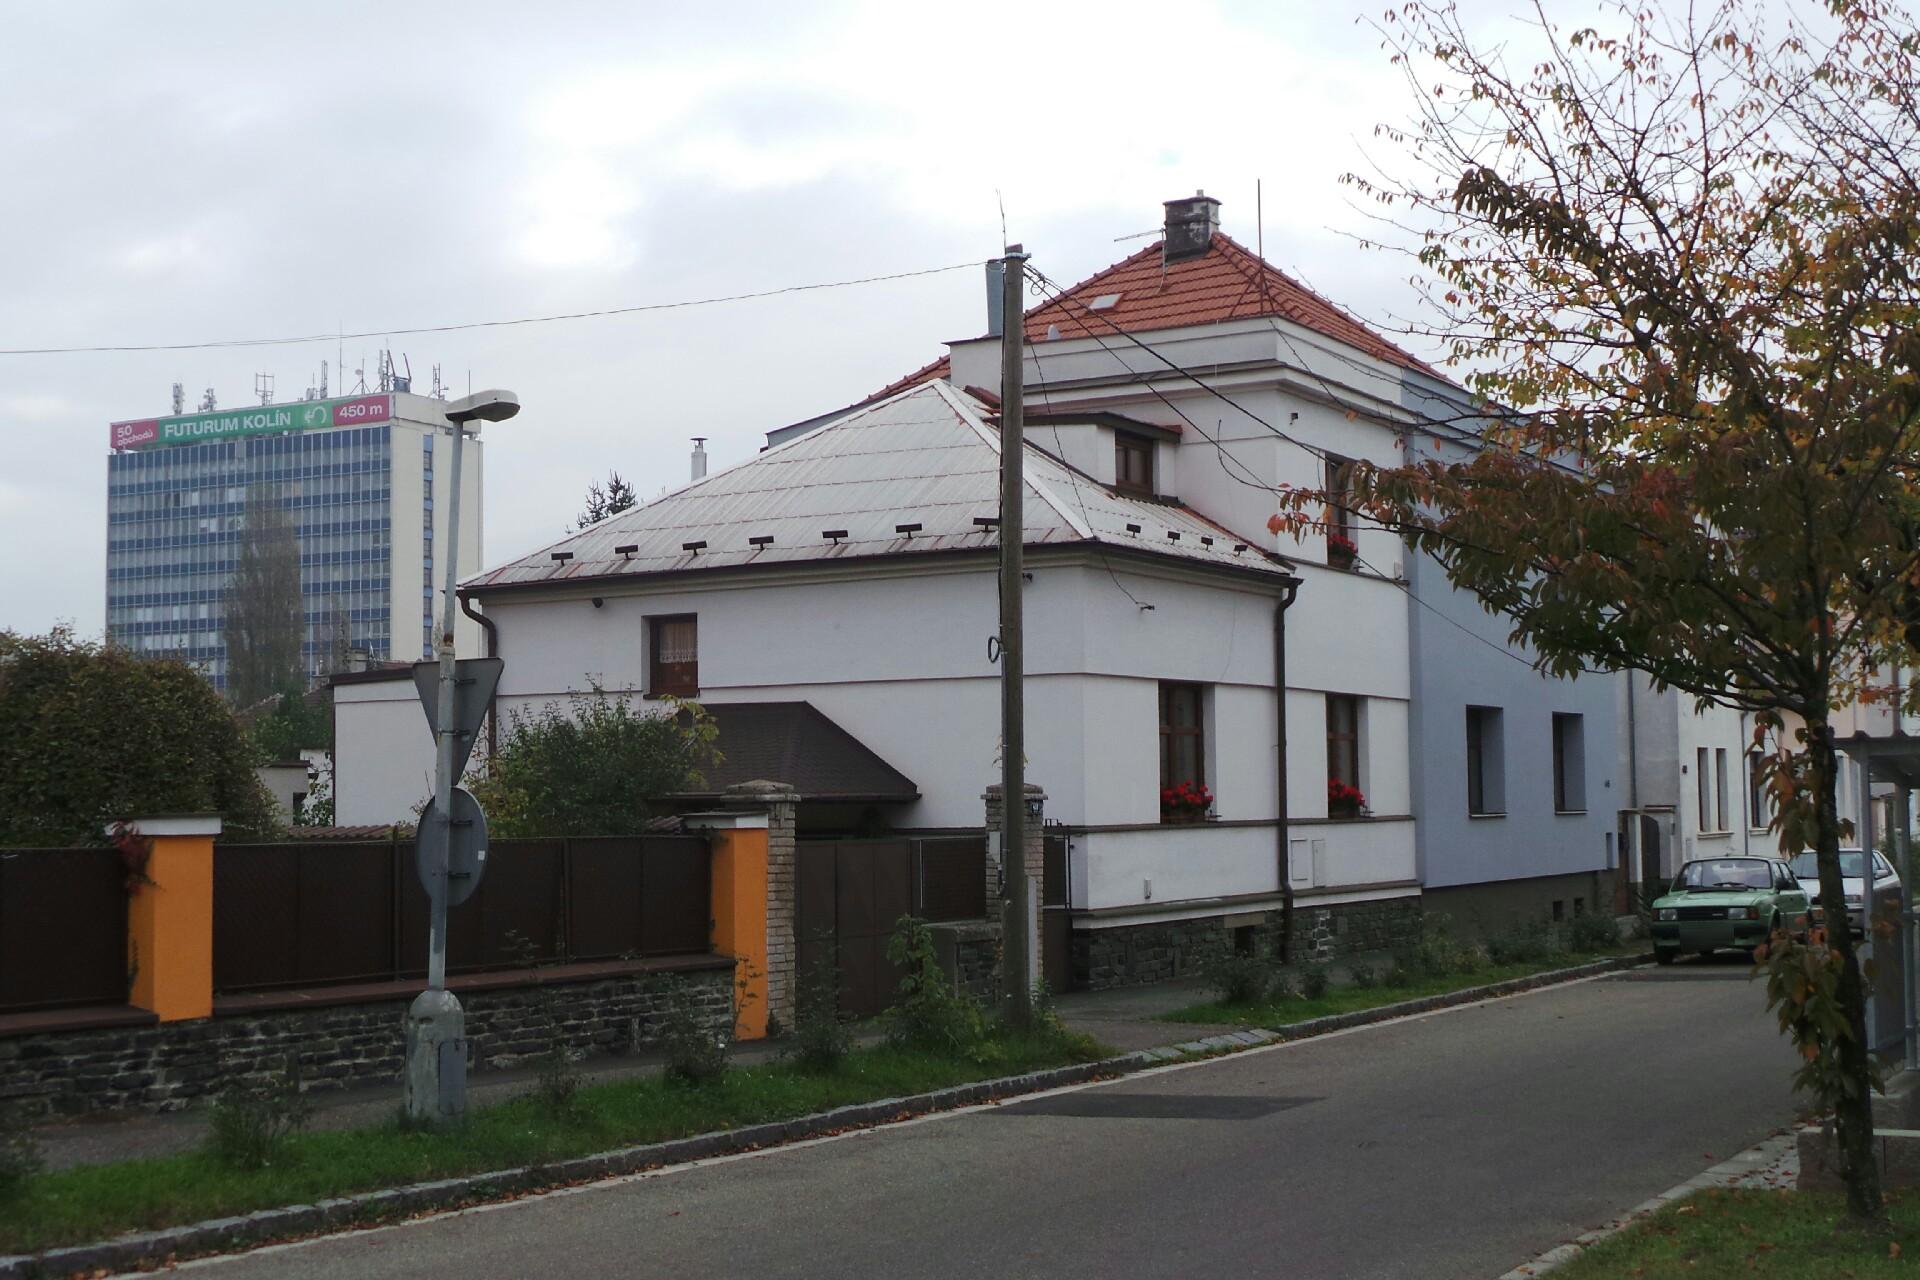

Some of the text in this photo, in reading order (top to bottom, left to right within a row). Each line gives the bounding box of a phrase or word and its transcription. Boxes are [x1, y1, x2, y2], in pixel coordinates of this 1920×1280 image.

[339, 404, 383, 418] 450 m
[117, 425, 133, 438] 50
[164, 409, 291, 438] FUTURUM KOLÍN
[117, 428, 154, 446] obchodů
